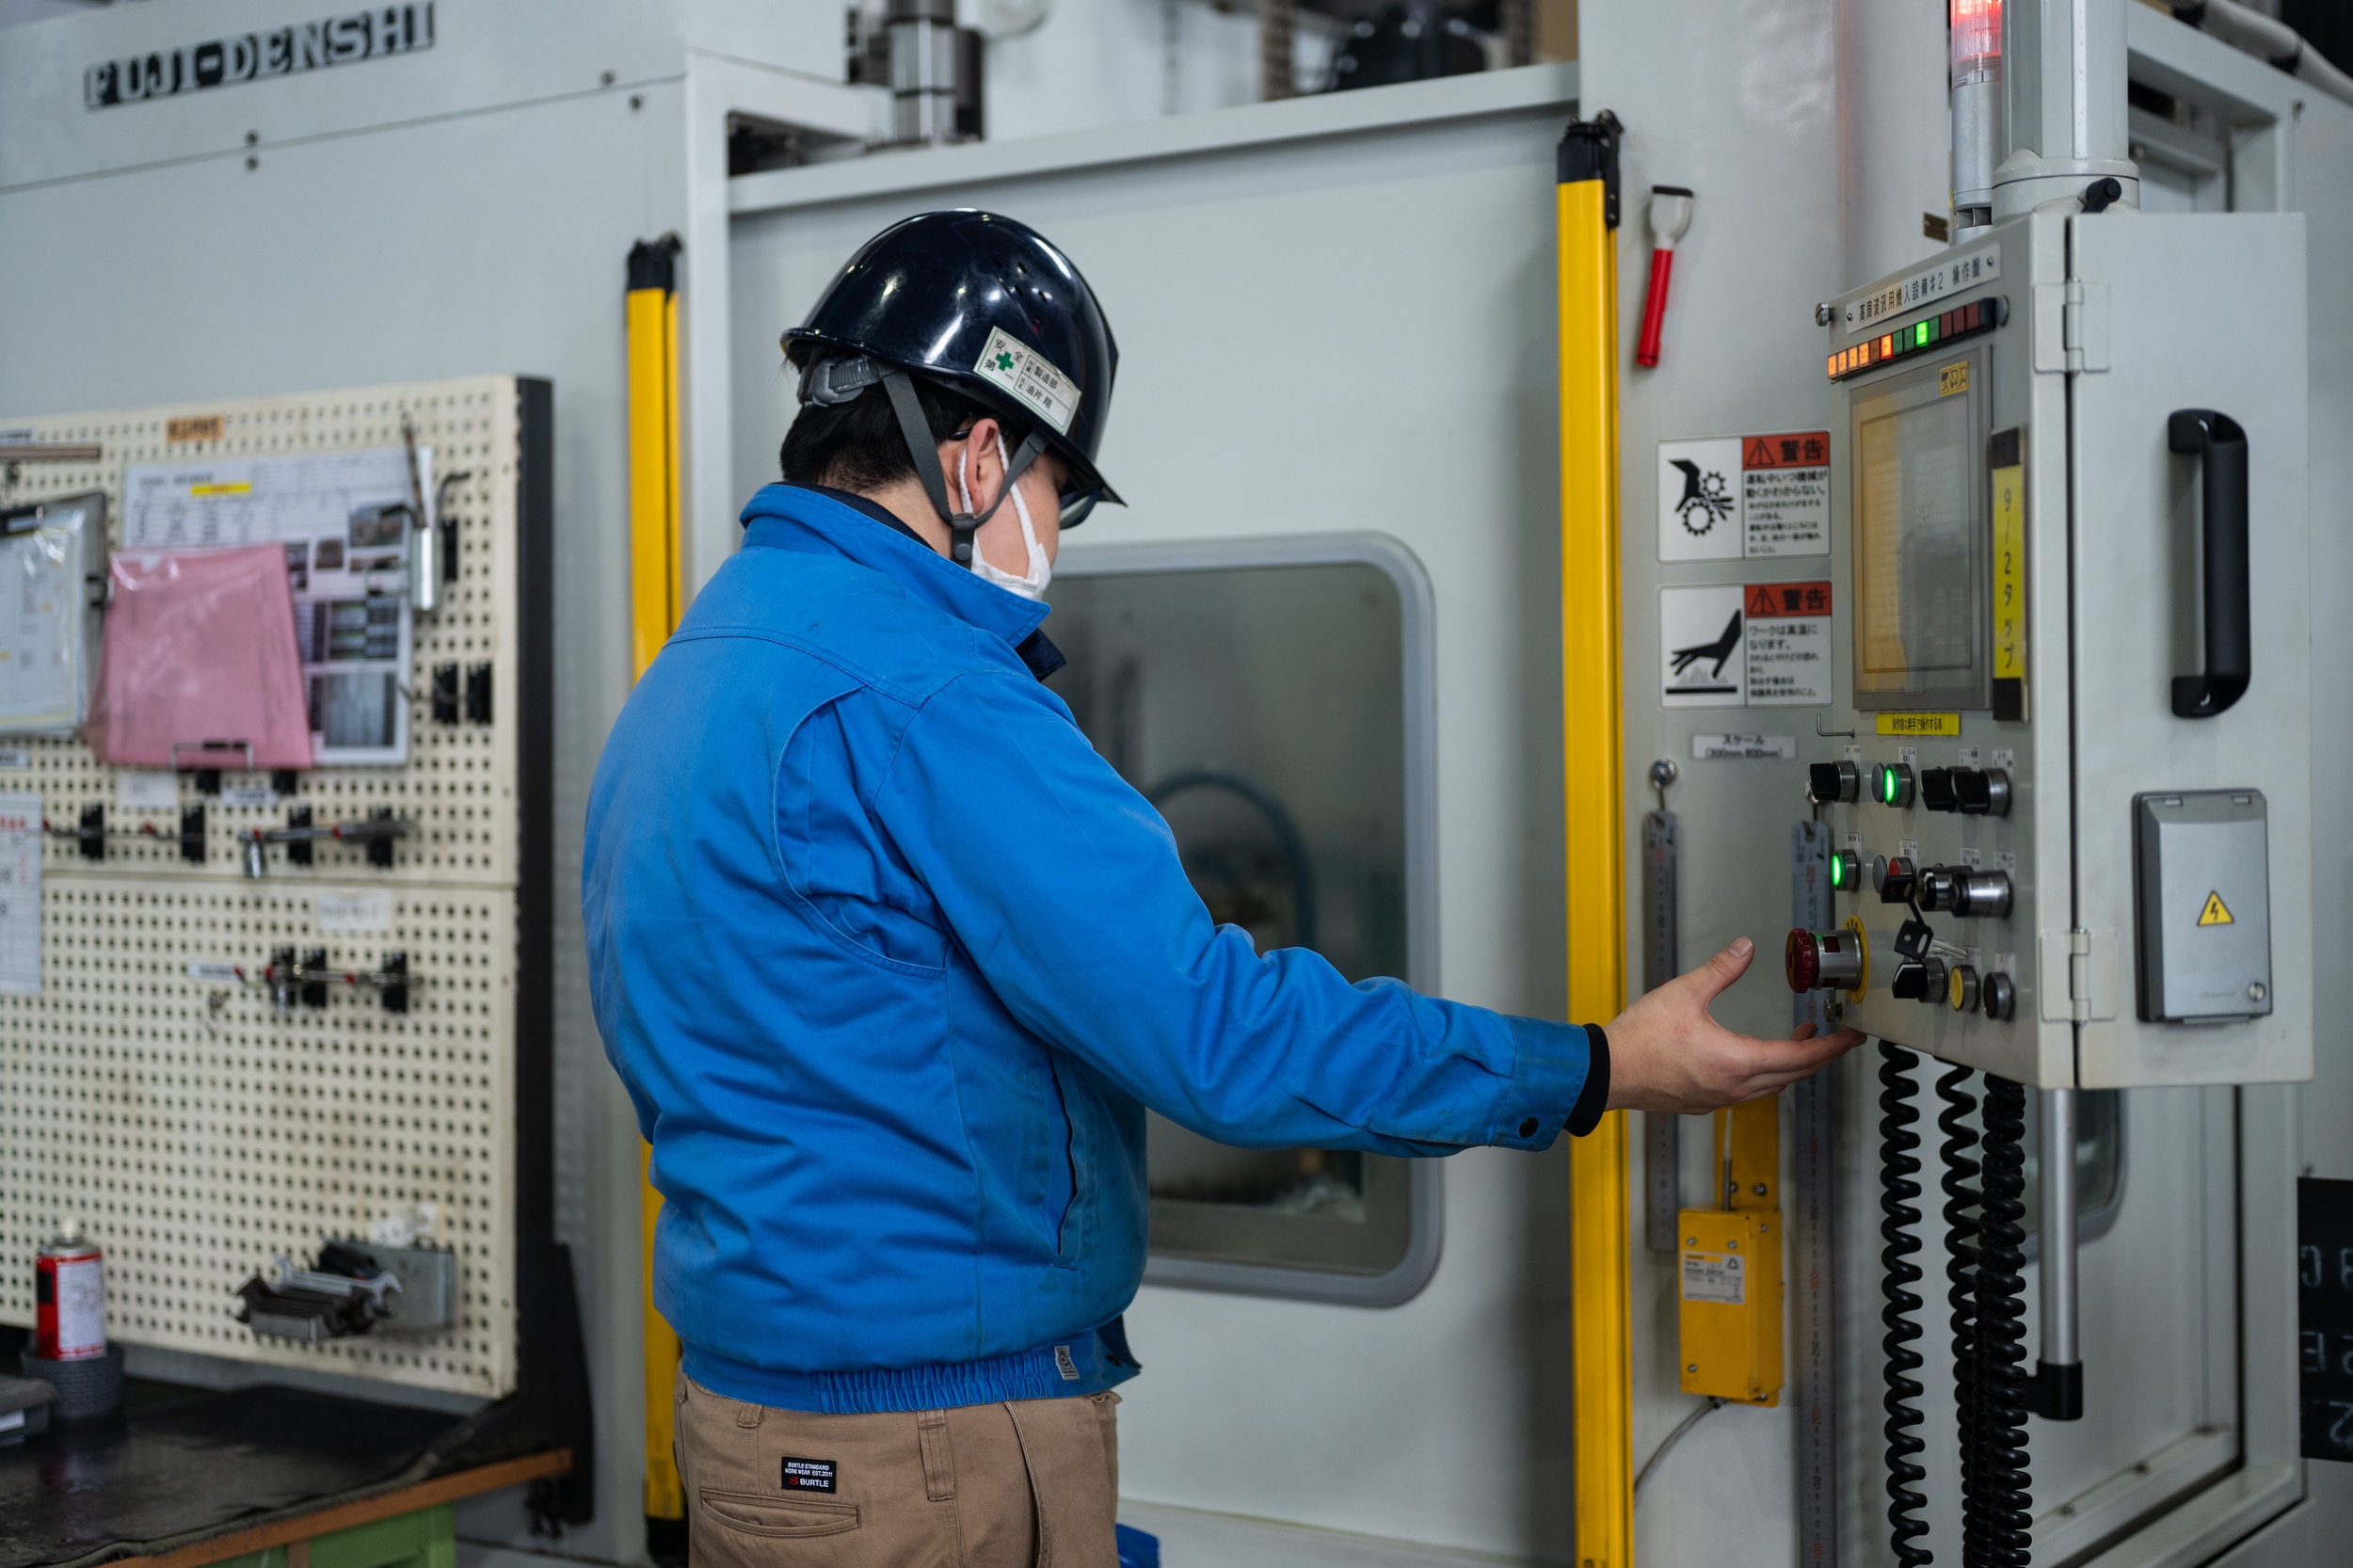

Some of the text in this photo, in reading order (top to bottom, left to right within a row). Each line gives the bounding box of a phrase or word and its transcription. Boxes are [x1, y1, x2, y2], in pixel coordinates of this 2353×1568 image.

[86, 1, 435, 110] FUJI-DENSHI
[1952, 257, 1980, 285] 操作盤
[1033, 365, 1059, 390] 製造部
[1780, 438, 1824, 462] 警告
[1783, 588, 1826, 612] 警告
[1749, 623, 1818, 636] ワークは高温に
[1749, 638, 1790, 650] なります。
[1723, 734, 1767, 746] スケール
[800, 1478, 829, 1487] BURTLE
[1812, 1543, 1823, 1559] 100
